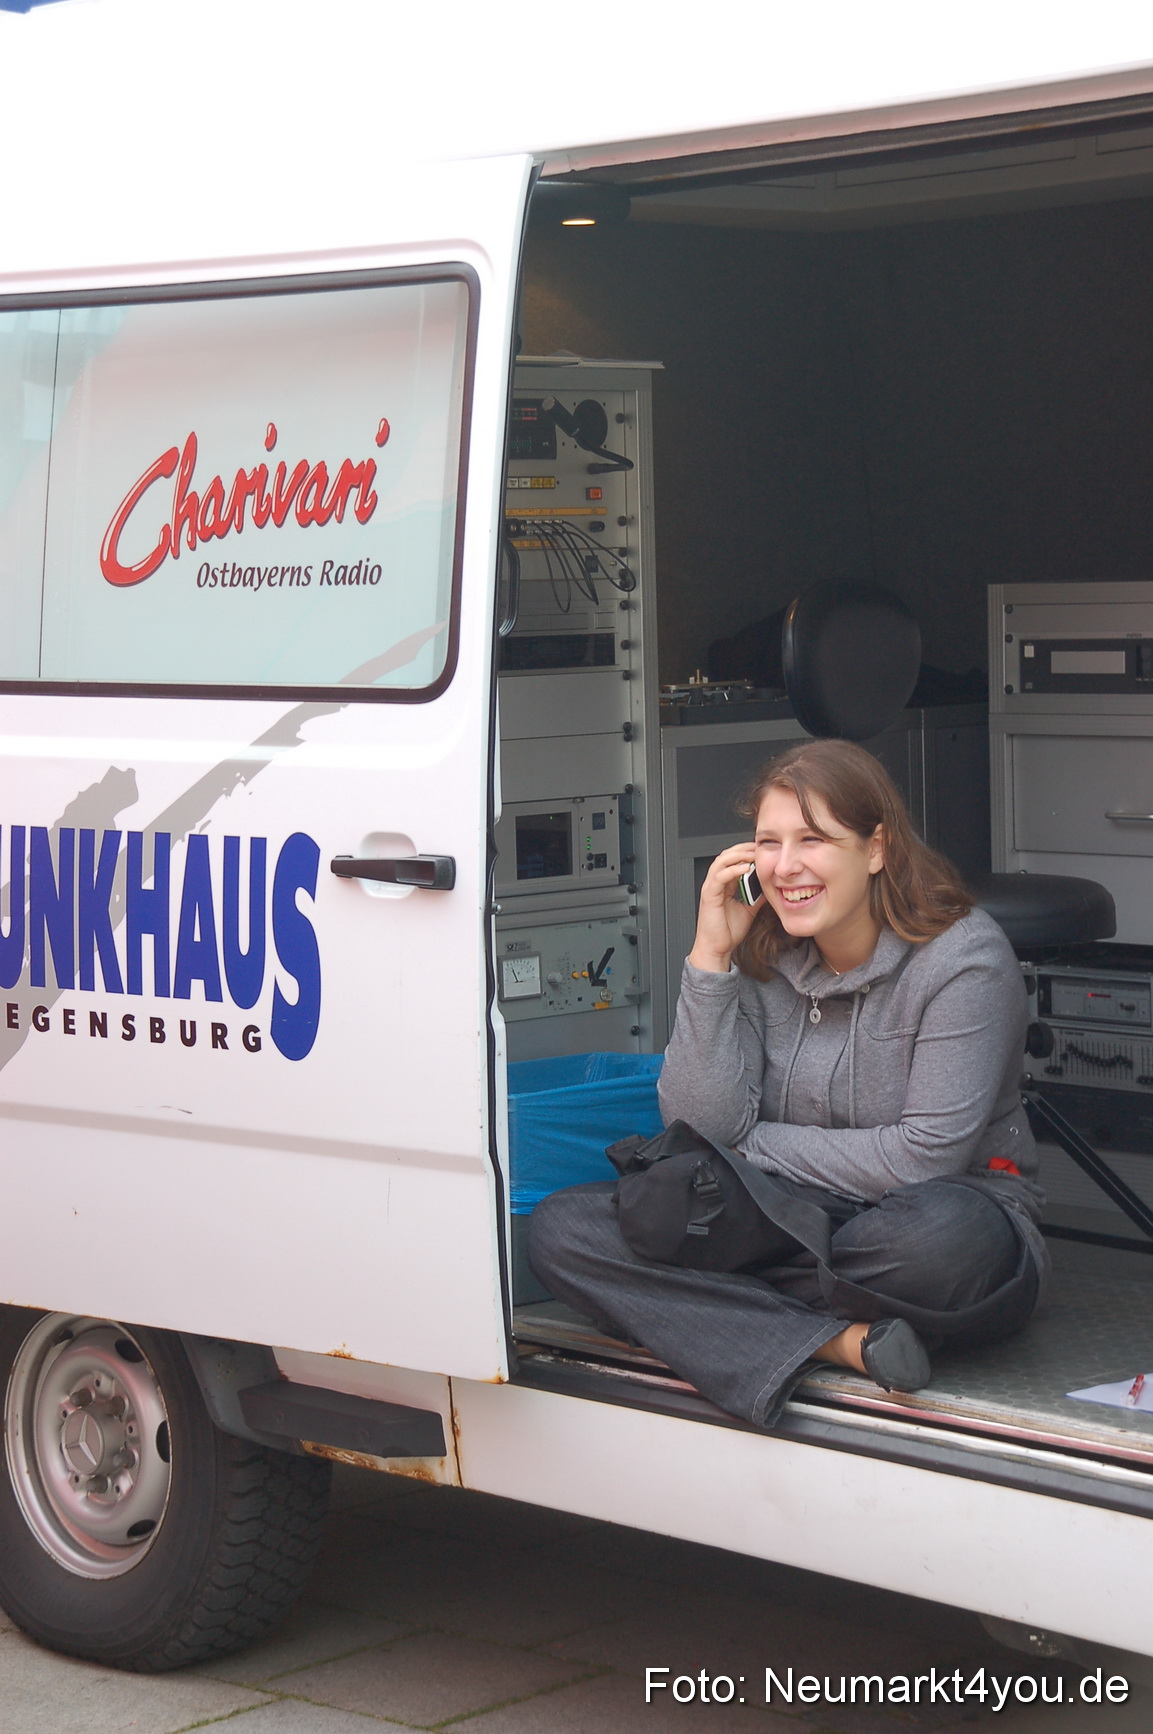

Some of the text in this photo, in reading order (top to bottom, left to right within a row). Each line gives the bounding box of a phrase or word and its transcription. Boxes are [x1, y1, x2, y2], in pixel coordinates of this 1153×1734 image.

[100, 418, 390, 587] Charivari
[197, 557, 382, 591] Ostbayerns Radio
